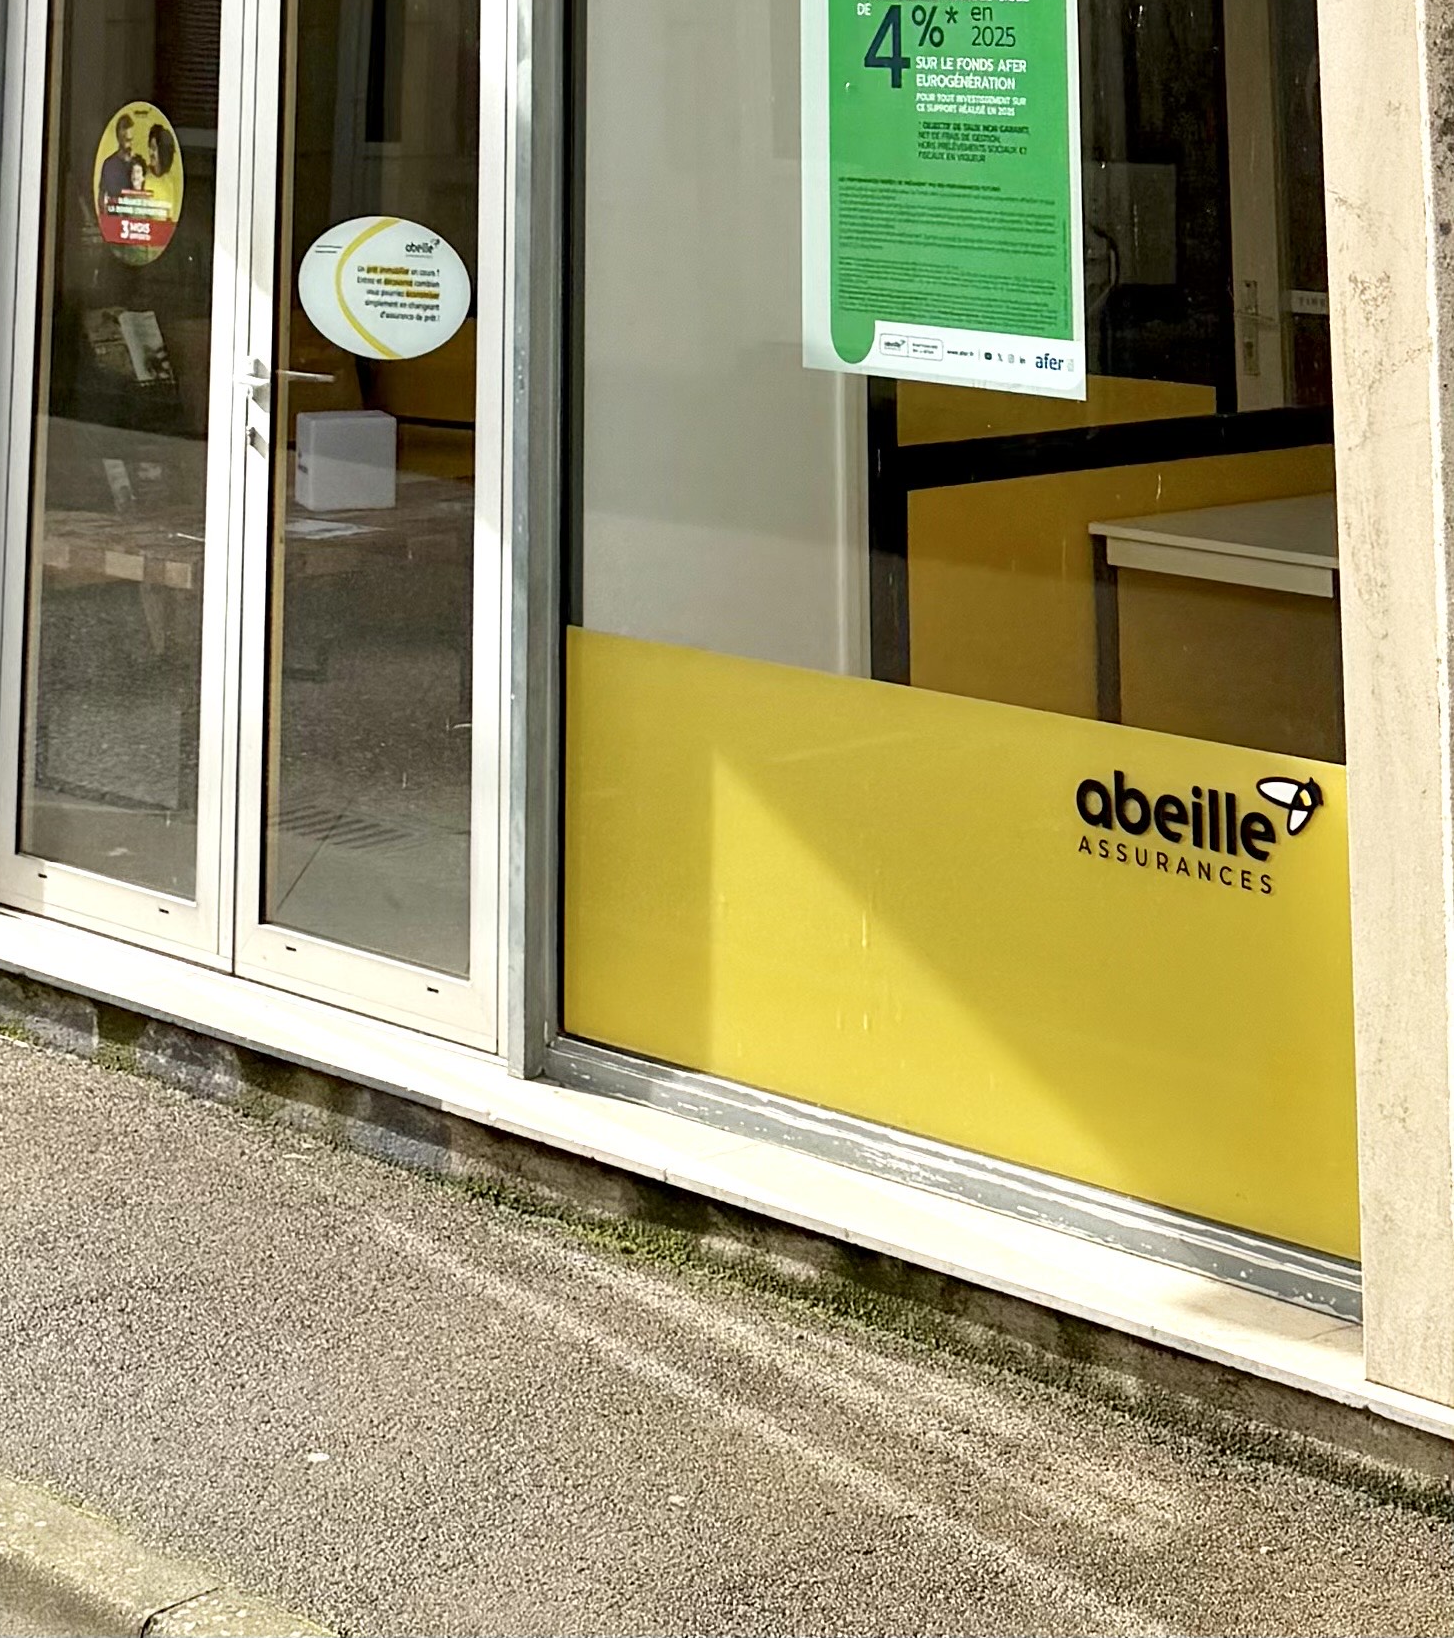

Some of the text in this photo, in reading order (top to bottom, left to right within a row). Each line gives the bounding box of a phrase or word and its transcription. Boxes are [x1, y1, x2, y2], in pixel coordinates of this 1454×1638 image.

[857, 3, 871, 16] DE
[970, 6, 993, 22] en
[971, 25, 1016, 48] 2025
[915, 56, 1027, 73] SUR LE FONDS AFER
[916, 73, 1016, 90] EUROGÉNÉRATION
[1035, 352, 1064, 371] afer
[1076, 770, 1277, 862] abeille
[1078, 834, 1274, 895] ASSURANCES
